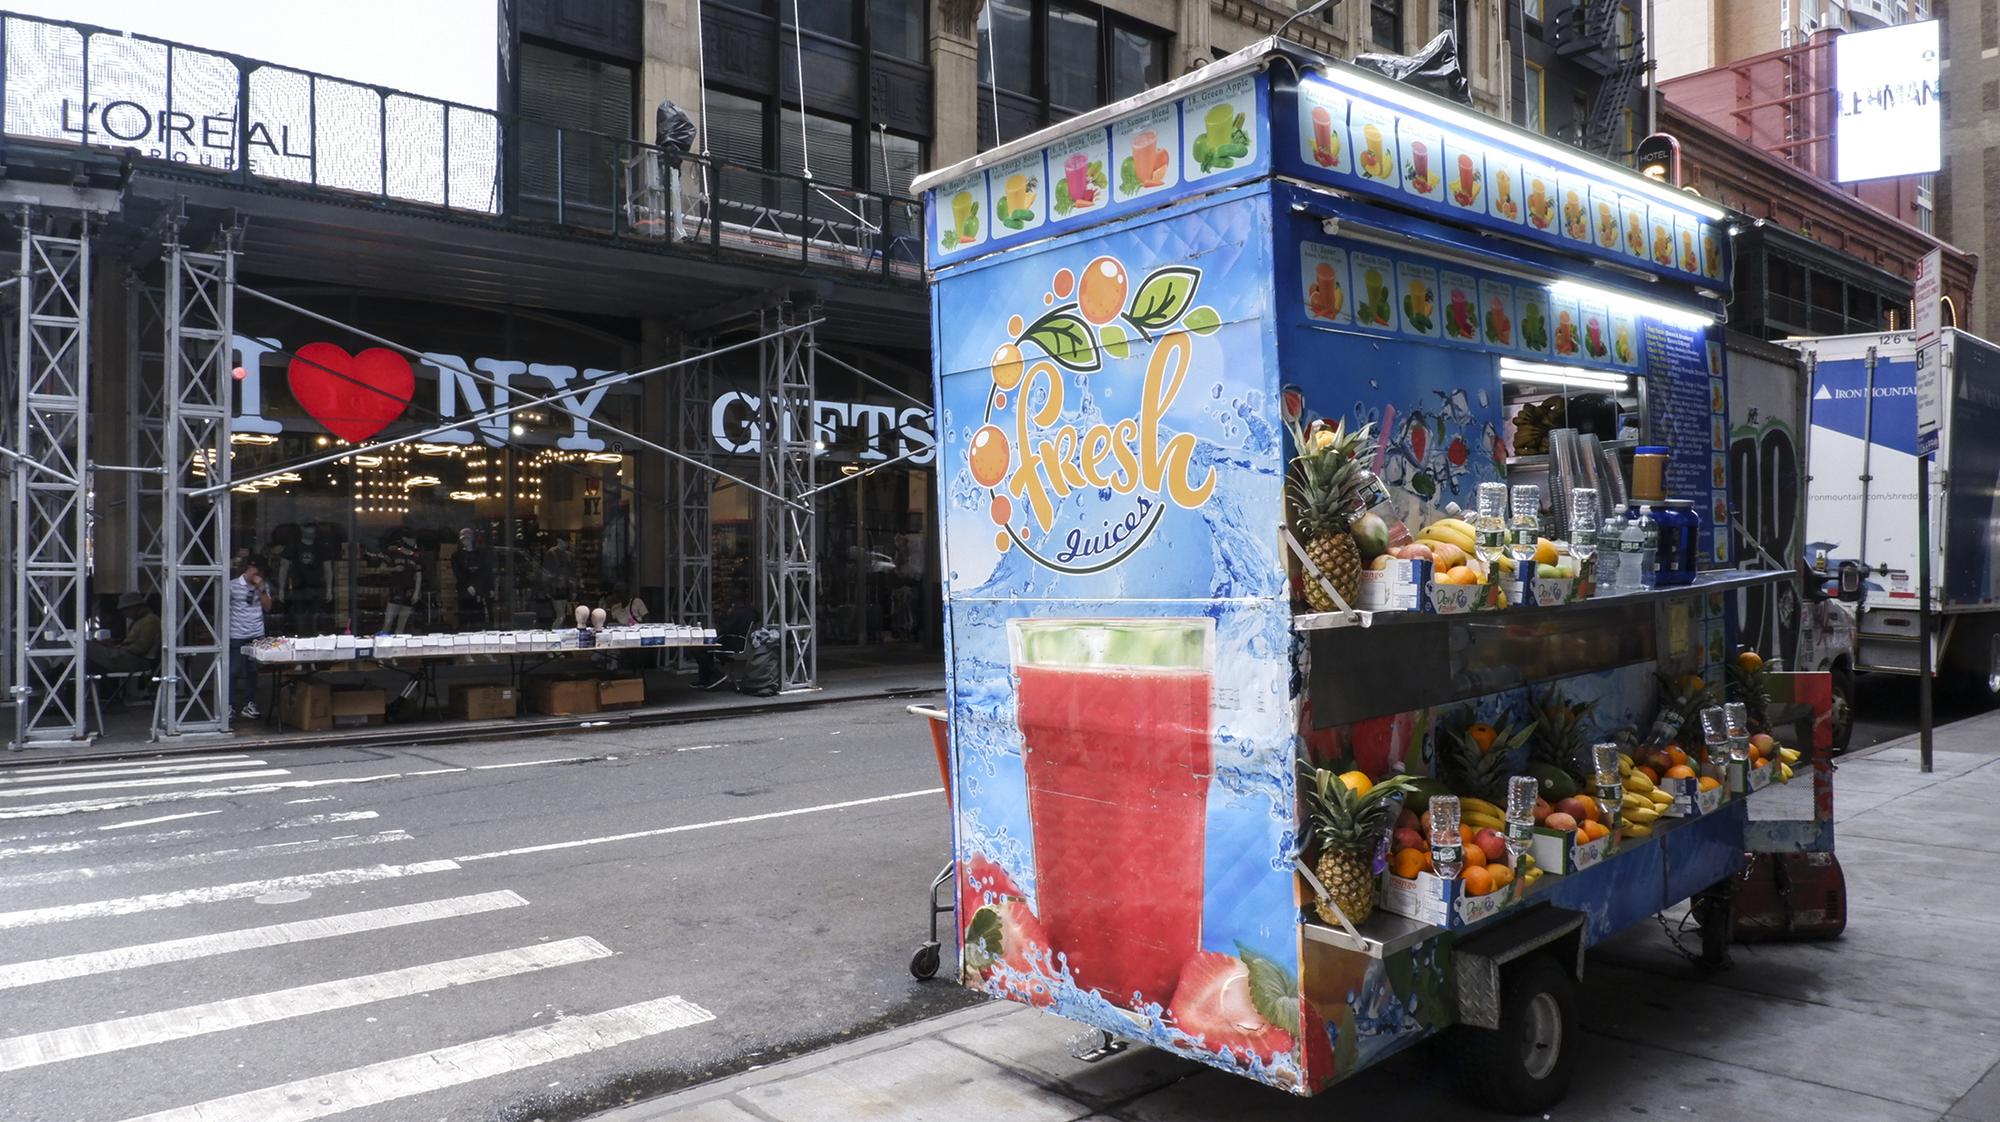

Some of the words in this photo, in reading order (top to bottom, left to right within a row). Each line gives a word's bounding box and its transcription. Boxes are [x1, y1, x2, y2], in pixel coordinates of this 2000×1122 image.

[1201, 88, 1224, 102] Green
[1225, 78, 1249, 93] Apple
[1127, 113, 1151, 127] Summer
[1151, 106, 1170, 120] Blend
[149, 147, 258, 173] ROUPE
[1639, 150, 1670, 162] HOTEL
[421, 353, 628, 452] NY
[1835, 388, 1863, 399] IRON
[711, 391, 936, 464] GIFTS
[1056, 495, 1153, 563] Juices
